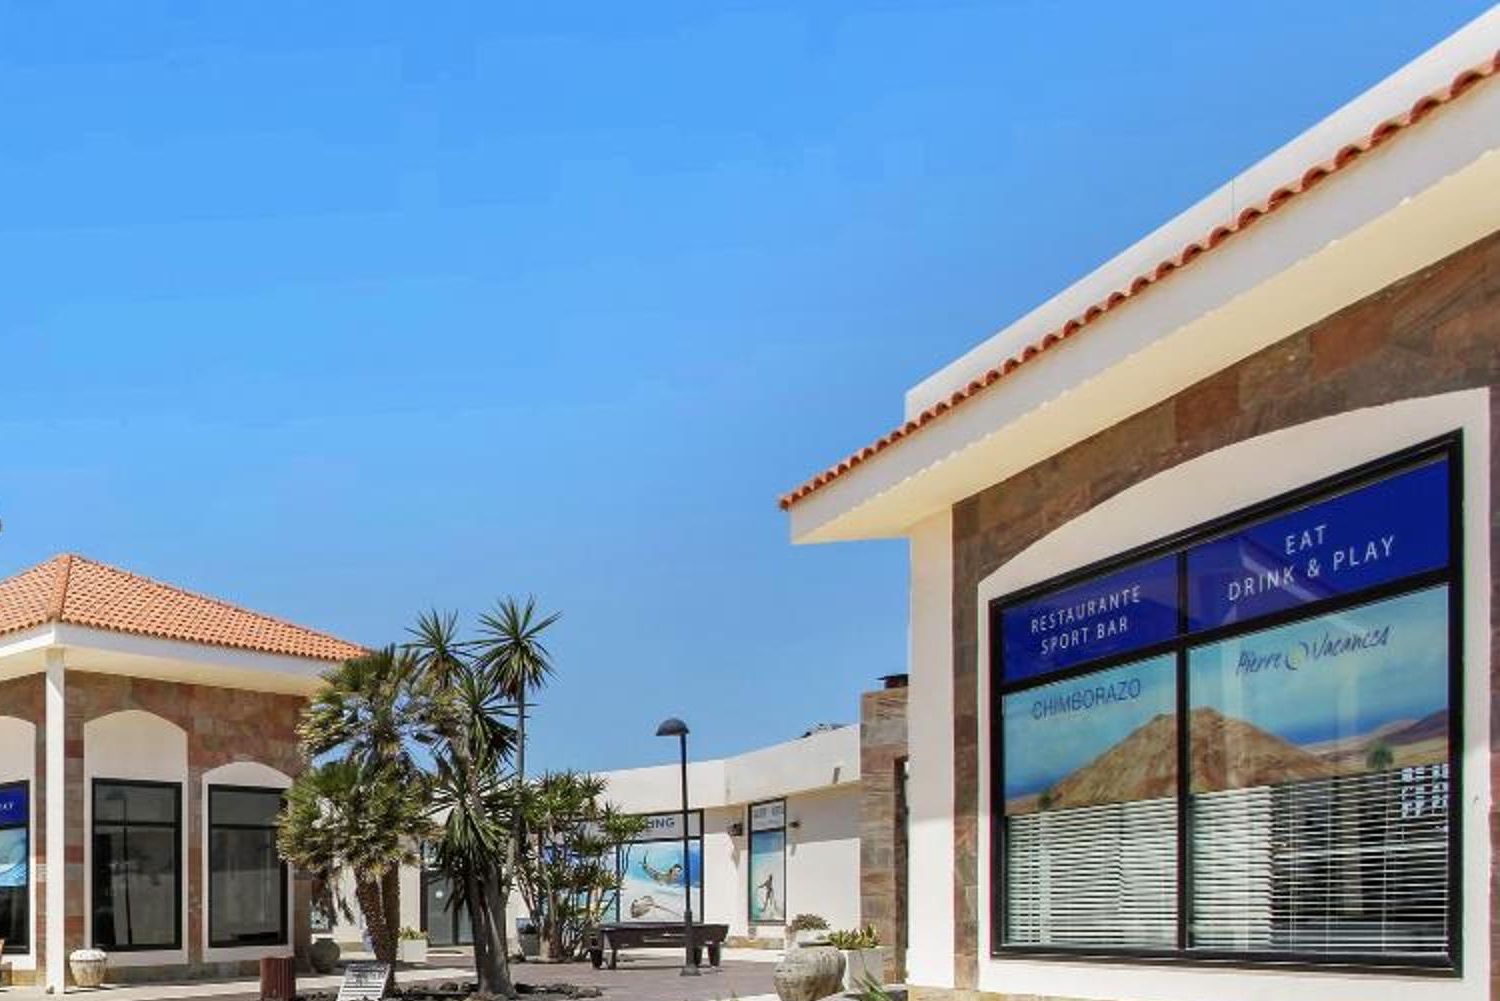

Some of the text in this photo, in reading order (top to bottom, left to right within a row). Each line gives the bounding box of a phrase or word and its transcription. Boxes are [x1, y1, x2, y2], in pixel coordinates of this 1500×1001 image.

[1284, 524, 1327, 555] EAT
[1228, 535, 1394, 601] DRINK & PLAY
[1031, 585, 1141, 634] RESTAURANTE
[1041, 616, 1128, 655] SPORT BAR
[1236, 623, 1392, 676] Pierre Vacances
[1031, 677, 1141, 721] CHIMBORAZO
